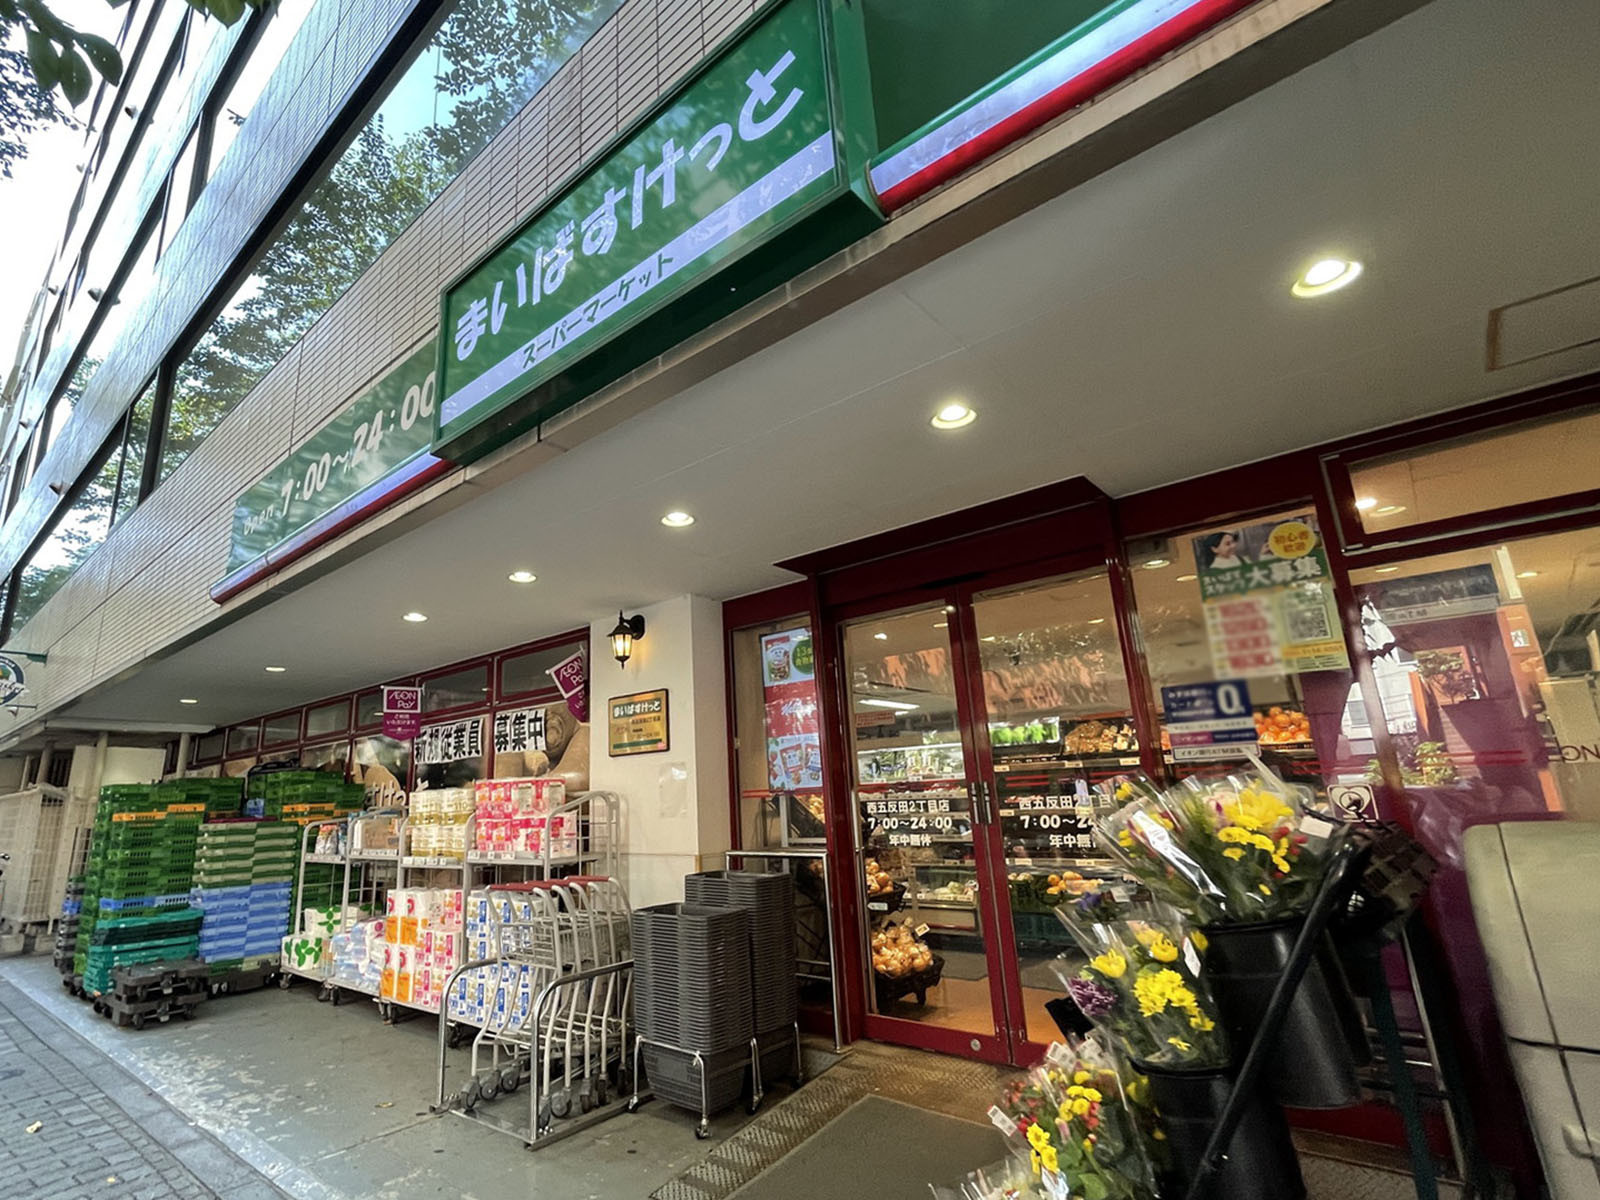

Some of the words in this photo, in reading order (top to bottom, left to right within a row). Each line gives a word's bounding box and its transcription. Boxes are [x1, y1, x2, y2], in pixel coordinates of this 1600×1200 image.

[454, 49, 804, 362] まいばすけっと
[522, 253, 674, 369] スーパーマーケット
[570, 674, 584, 686] Pa
[388, 690, 417, 700] AEON
[397, 700, 416, 709] Pay
[495, 710, 543, 752] 募集中
[866, 799, 950, 815] 西五反田2丁目店
[889, 833, 932, 847] 年中無休
[1048, 833, 1097, 849] 年中無
